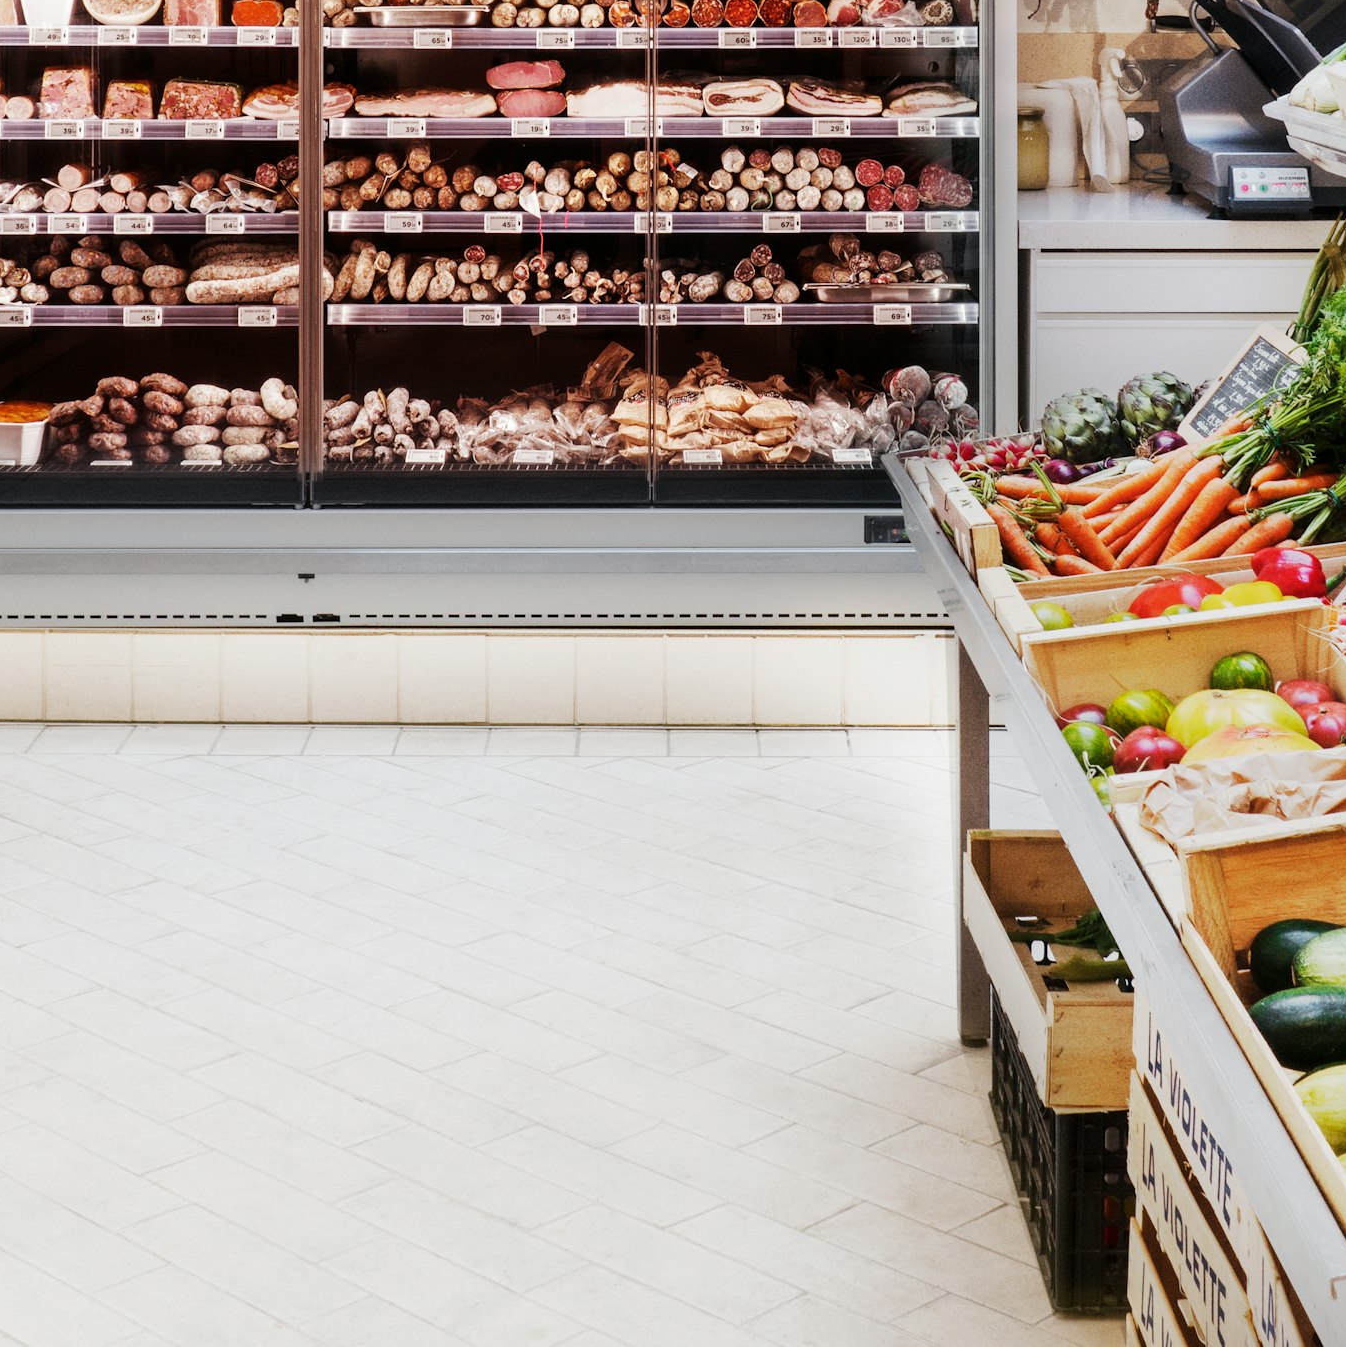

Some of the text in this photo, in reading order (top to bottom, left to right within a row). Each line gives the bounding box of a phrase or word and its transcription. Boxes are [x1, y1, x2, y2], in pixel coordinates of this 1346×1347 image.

[1147, 1011, 1234, 1230] LA VIOLETTE
[1140, 1261, 1155, 1334] LA
[1141, 1123, 1228, 1347] LA VIOLETTE
[1261, 1255, 1277, 1343] LA
